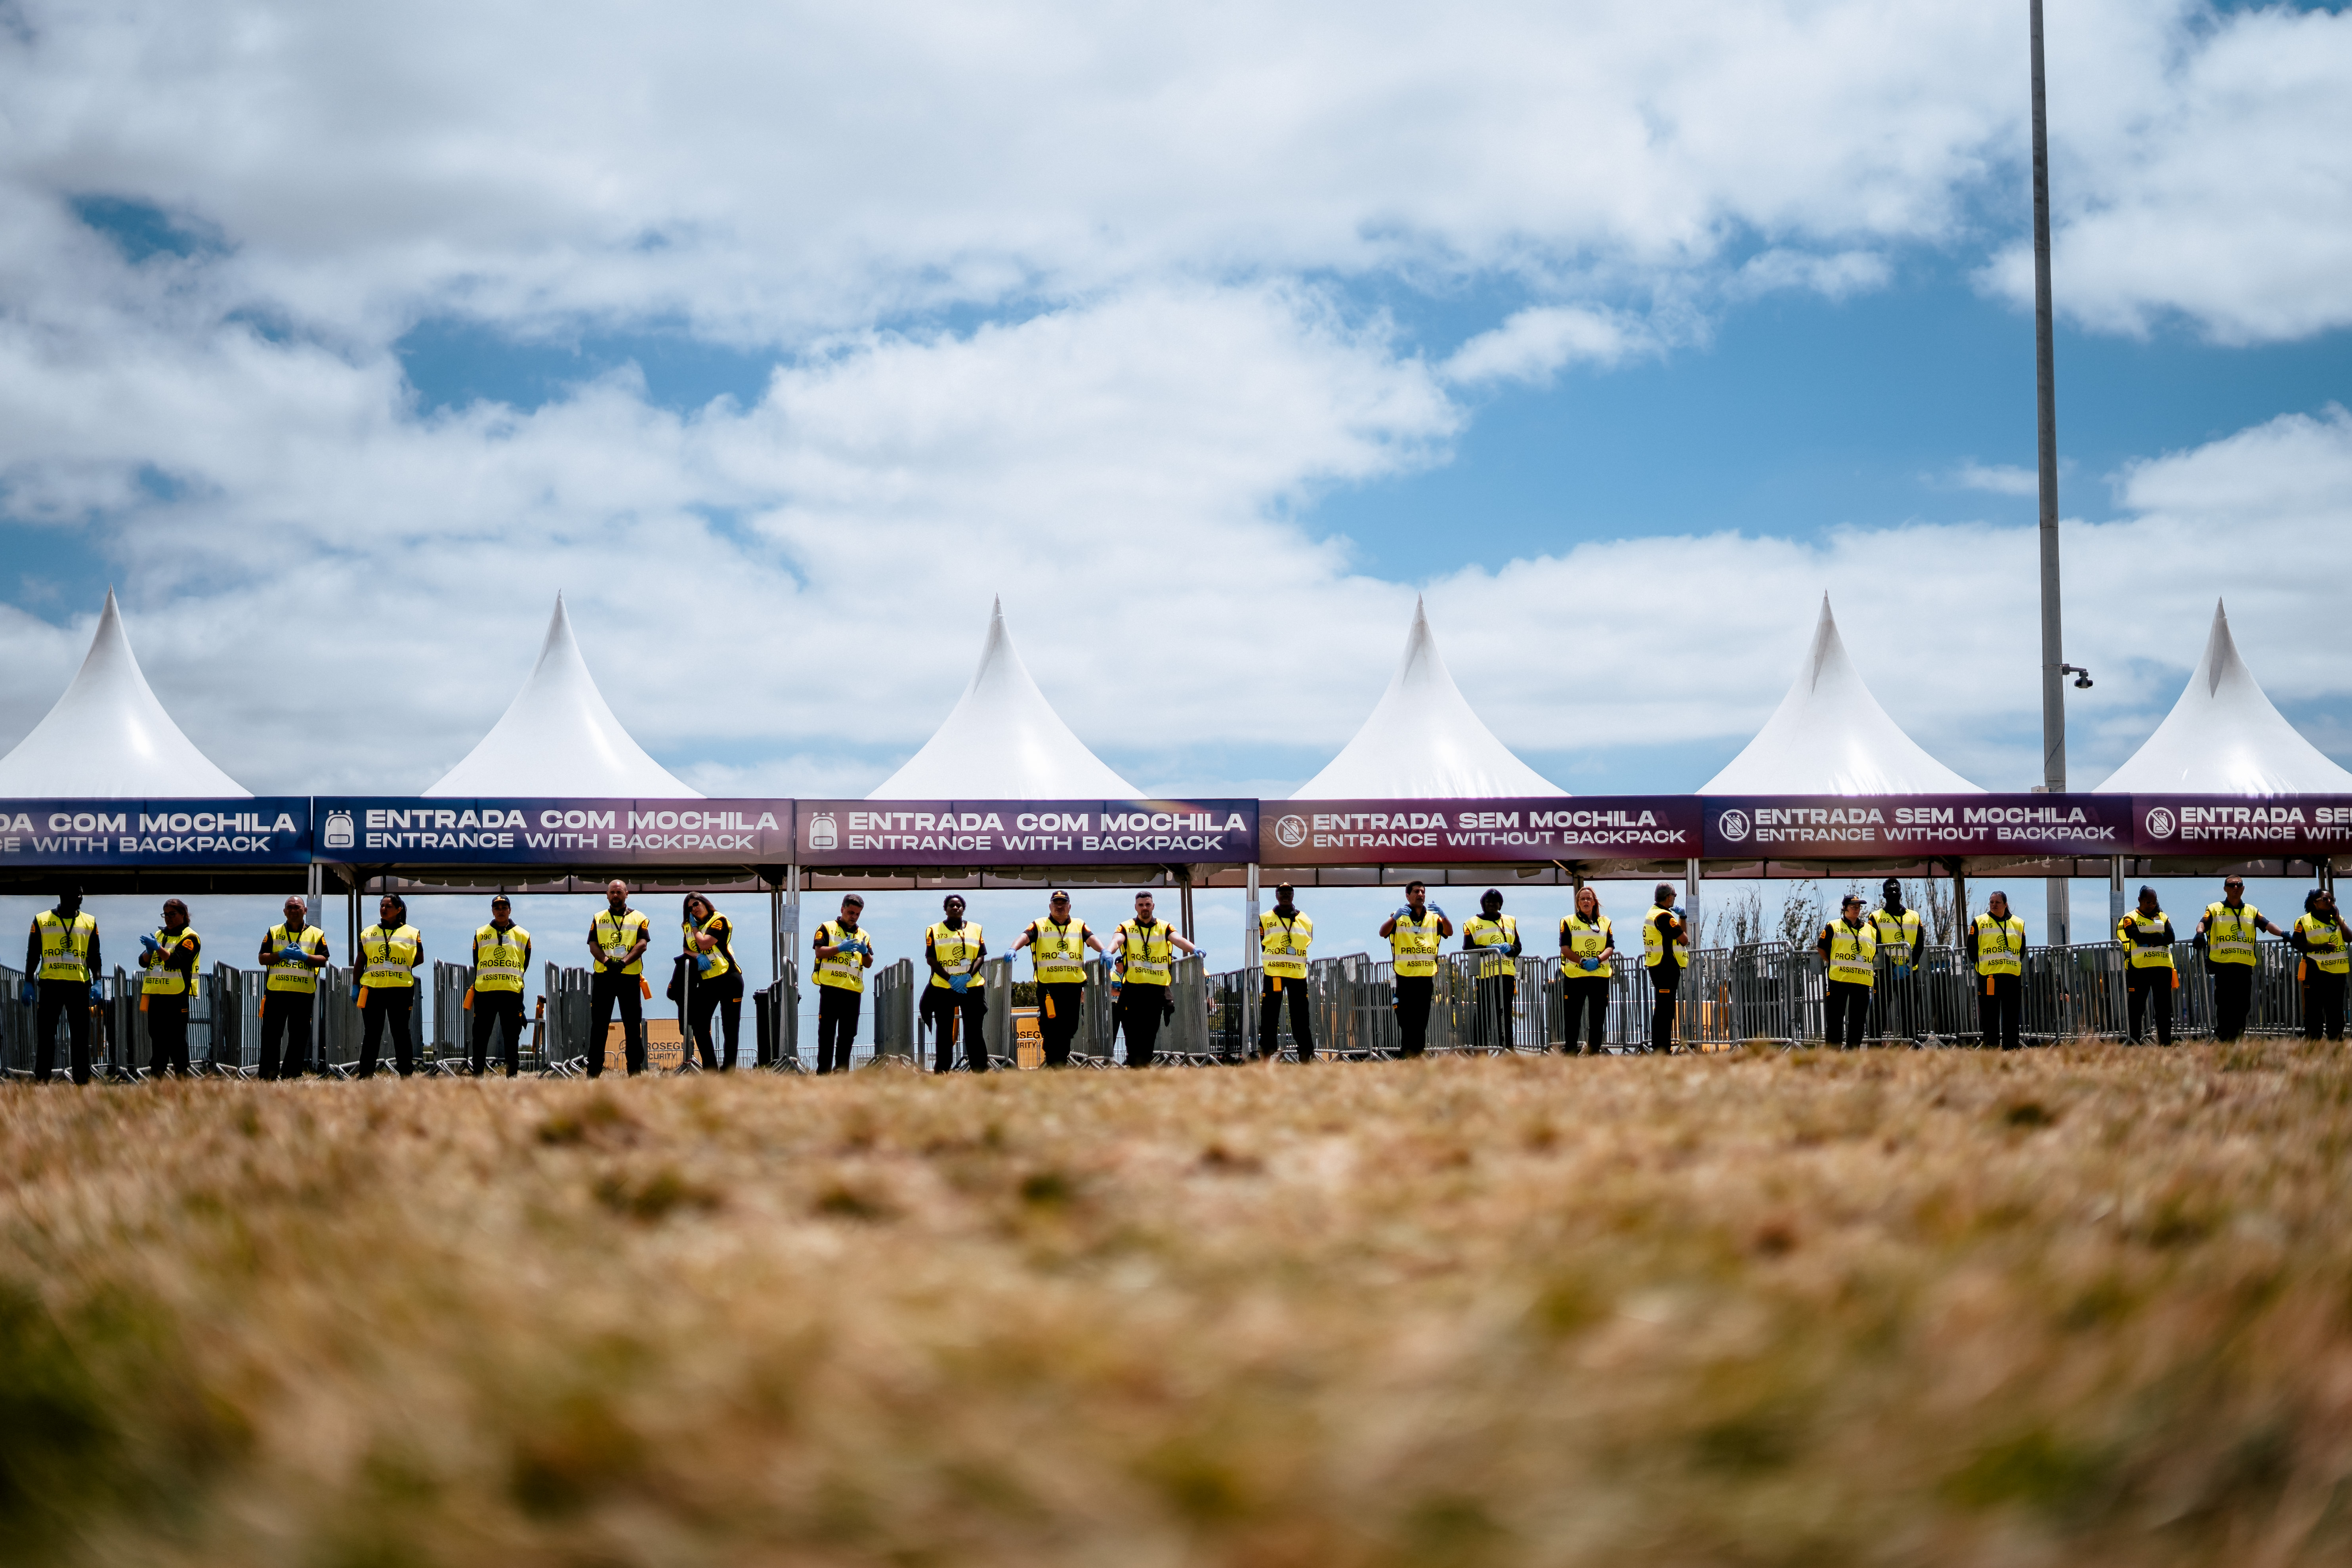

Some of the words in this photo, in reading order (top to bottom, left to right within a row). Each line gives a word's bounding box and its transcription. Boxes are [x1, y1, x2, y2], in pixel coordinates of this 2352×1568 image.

[367, 810, 527, 828] ENTRADA
[540, 810, 615, 829] COM
[628, 811, 779, 830] MOCHILA
[1313, 813, 1448, 830] ENTRADA
[1459, 812, 1519, 829] SEM
[1530, 810, 1657, 827] MOCHILA
[1755, 808, 1885, 825] ENTRADA
[1896, 808, 1953, 824] SEM
[1964, 808, 2087, 823] MOCHILA
[2181, 807, 2305, 823] ENTRADA
[2315, 807, 2352, 823] SE
[49, 813, 126, 832] COM
[139, 813, 296, 832] MOCHILA
[849, 812, 1004, 831] ENTRADA
[1017, 813, 1088, 831] COM
[1101, 814, 1247, 831] MOCHILA
[1314, 833, 1437, 847] ENTRANCE
[1446, 832, 1554, 846] WITHOUT
[1564, 830, 1685, 844] BACKPACK
[1756, 828, 1875, 841] ENTRANCE
[1883, 827, 1988, 840] WITHOUT
[1997, 827, 2115, 839] BACKPACK
[2181, 827, 2295, 839] ENTRANCE
[0, 837, 20, 852] E
[32, 837, 108, 852] WITH
[120, 837, 271, 852] BACKPACK
[366, 833, 513, 848] ENTRANCE
[525, 833, 598, 848] WITH
[609, 834, 754, 849] BACKPACK
[849, 835, 991, 850] ENTRANCE
[1002, 836, 1071, 850] WITH
[1083, 836, 1222, 850] BACKPACK
[2216, 935, 2254, 944] PROSEGU
[1042, 952, 1082, 961] PROGUR
[1131, 953, 1167, 963] ROSEGUR
[1266, 947, 1306, 957] PROSUR
[1835, 953, 1872, 963] PROSGU
[2221, 948, 2252, 956] ASSISTENTE
[480, 959, 521, 970] PROSEGUR
[1268, 961, 1301, 970] ASSISTENTE
[1135, 967, 1164, 976] SSISTENTE
[1839, 966, 1871, 976] ASSISTENTE
[275, 974, 308, 984] ASSISTENTE
